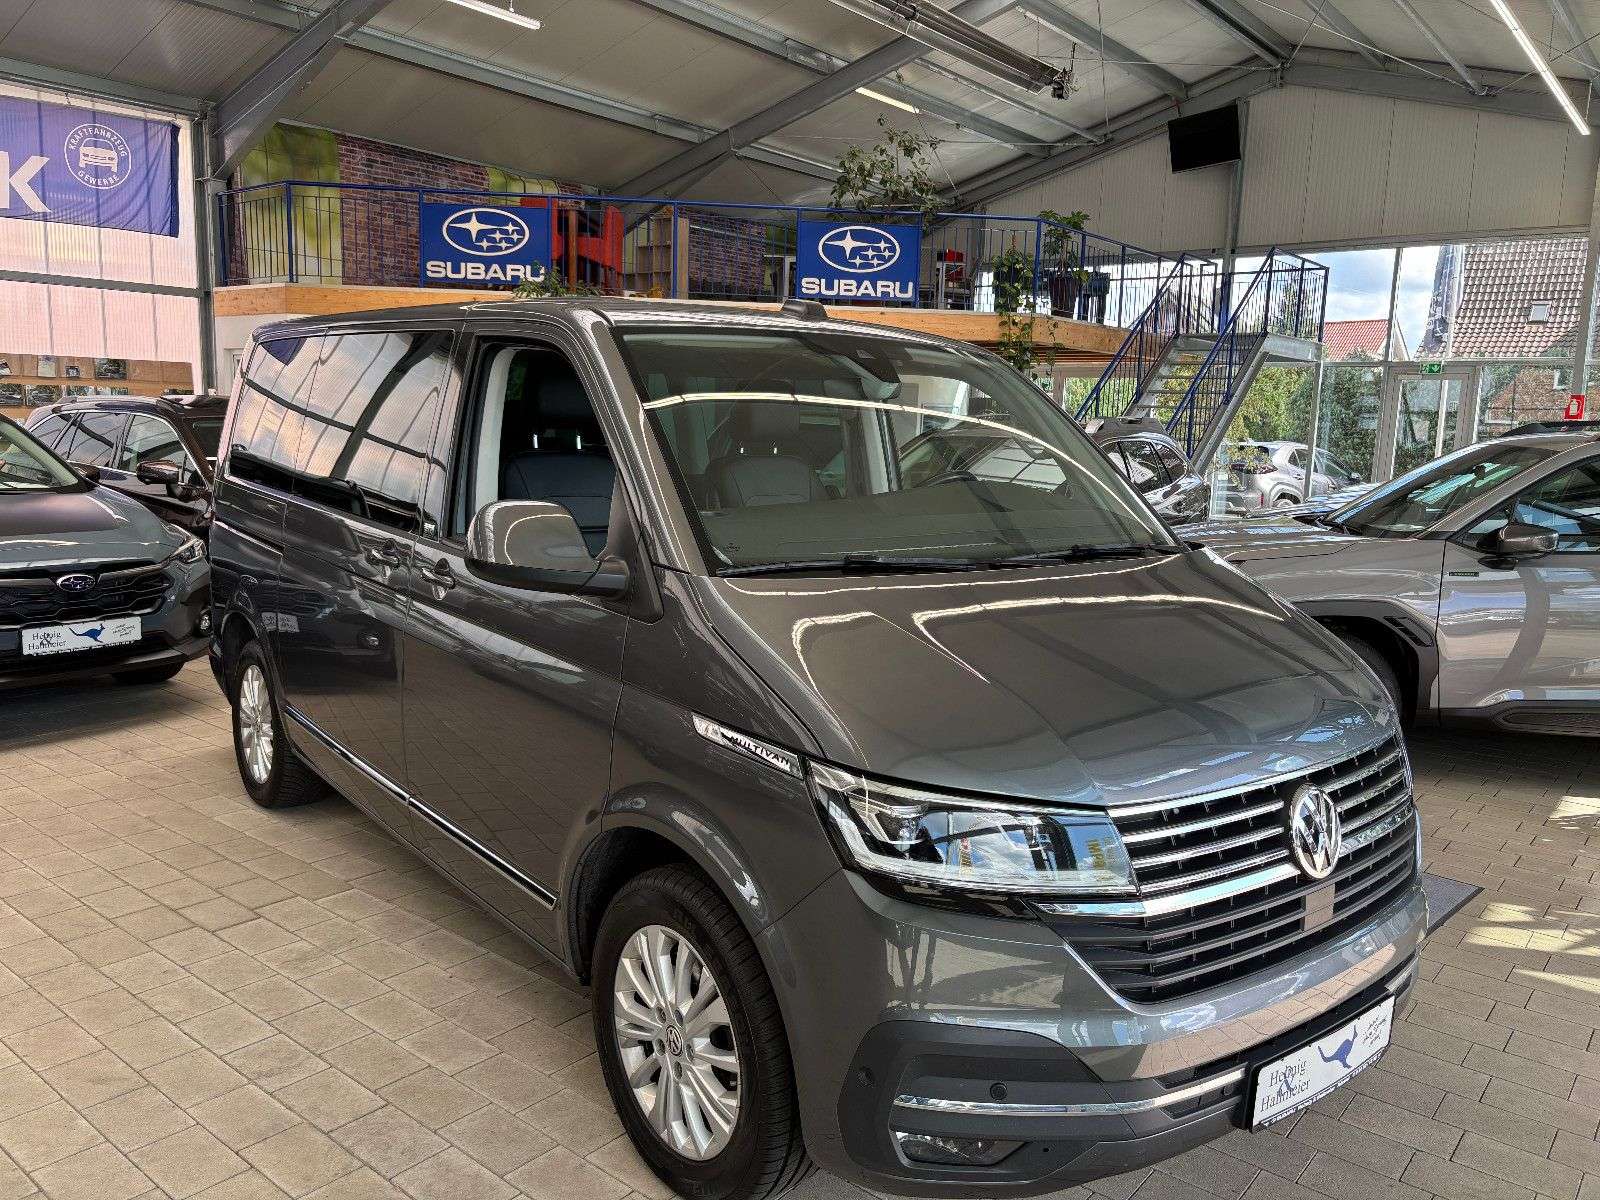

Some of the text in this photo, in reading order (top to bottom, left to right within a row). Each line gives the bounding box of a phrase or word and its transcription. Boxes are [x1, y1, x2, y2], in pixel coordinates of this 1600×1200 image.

[69, 127, 128, 157] KRAFTFAHRZEUG
[78, 170, 119, 186] GEWERBE
[426, 260, 545, 282] SUBARU
[801, 277, 913, 298] SUBARU
[730, 736, 790, 766] MULTIVAN
